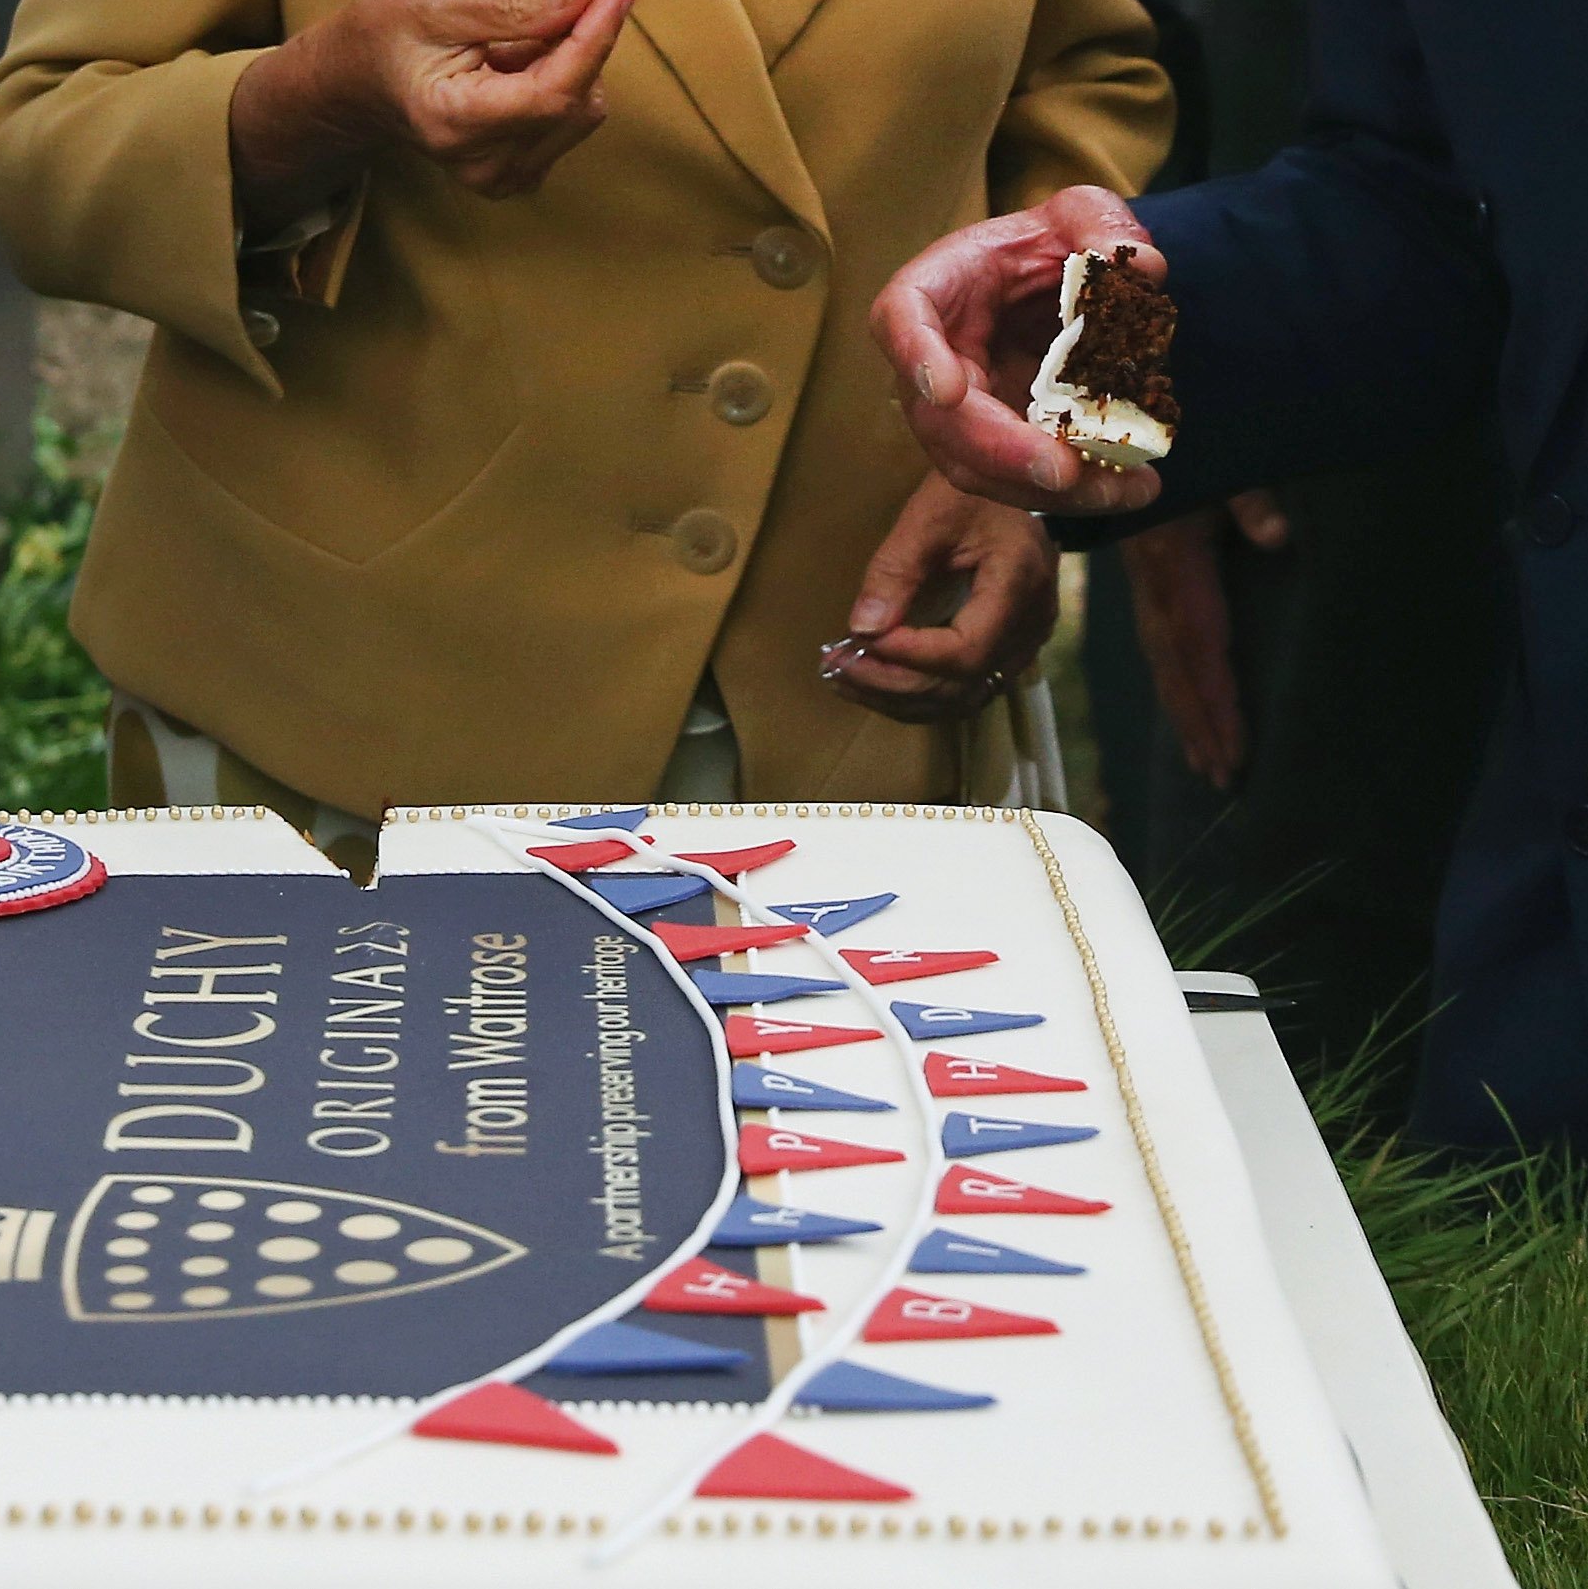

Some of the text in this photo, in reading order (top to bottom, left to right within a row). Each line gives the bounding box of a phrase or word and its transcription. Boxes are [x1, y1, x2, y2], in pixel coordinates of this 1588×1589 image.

[103, 926, 288, 1152] DUCHY
[307, 921, 411, 1158] ORIGINALS
[435, 932, 528, 1157] from Waitrose
[581, 935, 657, 1261] A partnership preserving our heritage
